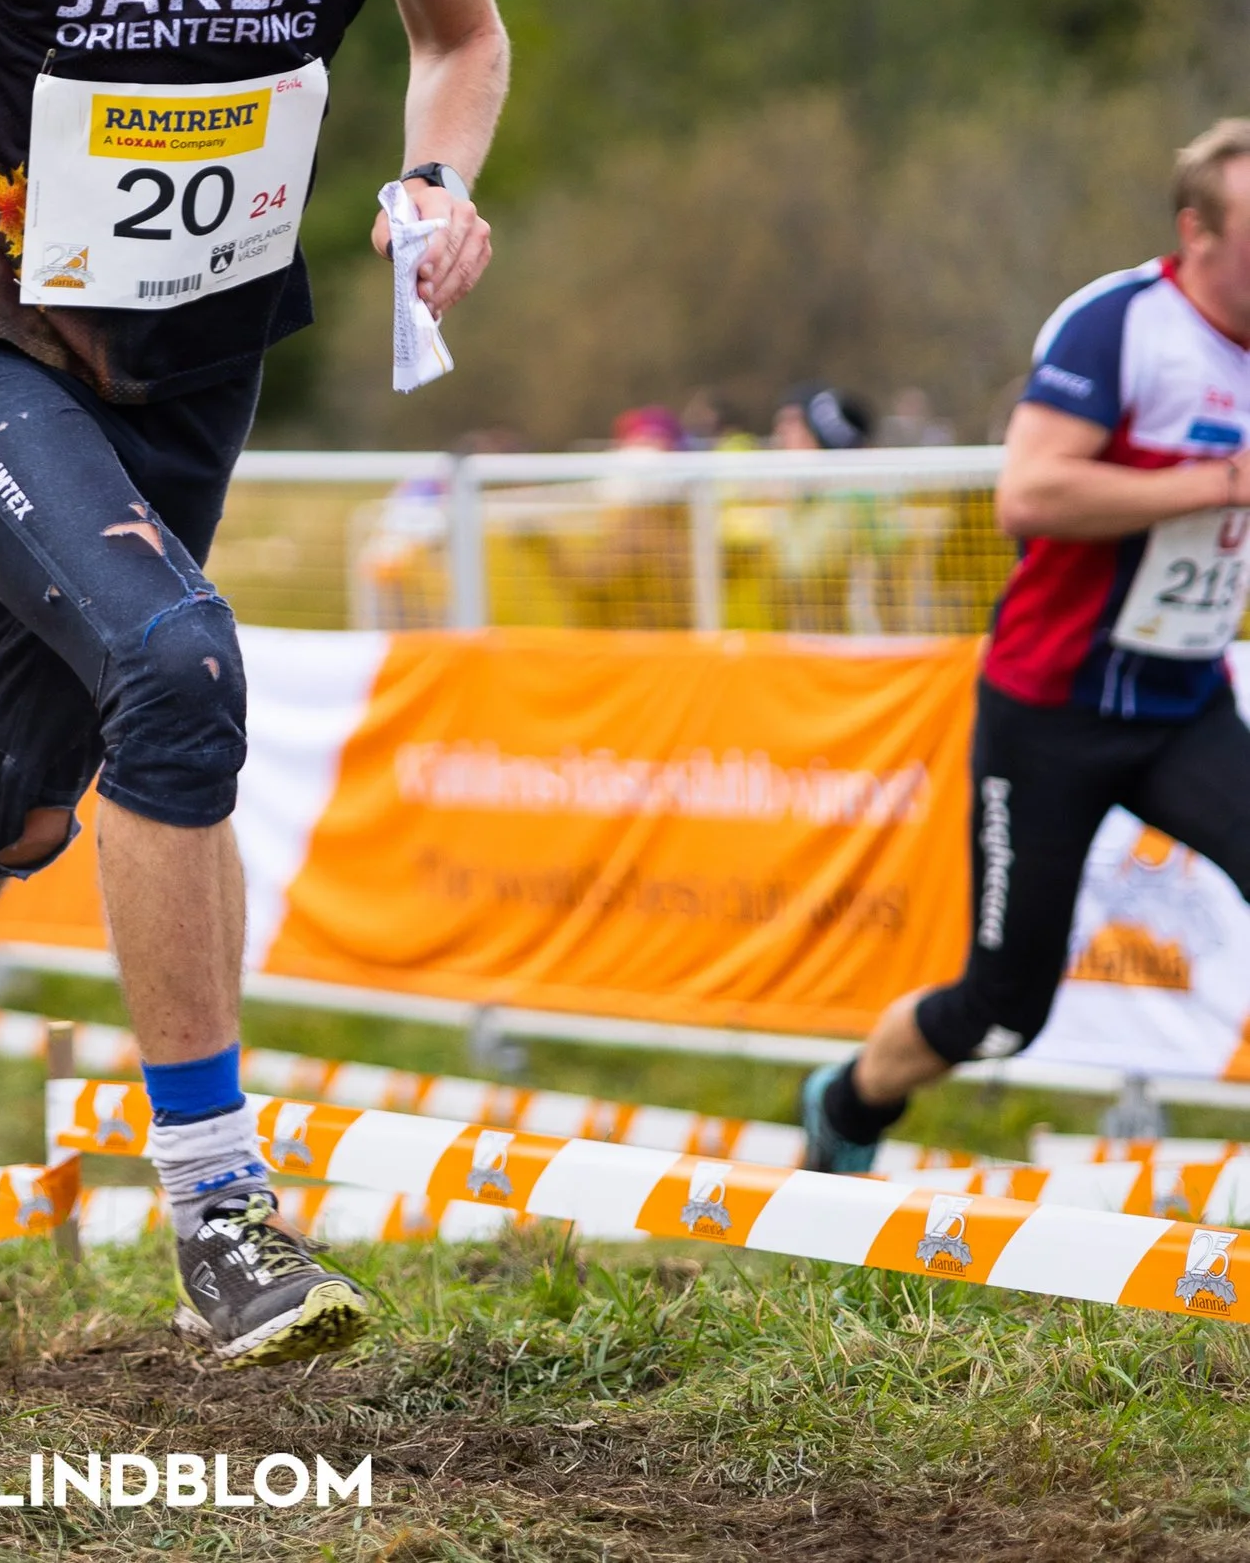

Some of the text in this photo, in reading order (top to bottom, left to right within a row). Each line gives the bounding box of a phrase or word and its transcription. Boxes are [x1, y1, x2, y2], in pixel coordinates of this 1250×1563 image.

[56, 10, 318, 50] ORIENTERING
[104, 102, 259, 132] RAMIRENT
[103, 135, 227, 150] A LOXAM Company
[113, 165, 235, 240] 20
[249, 184, 287, 219] 24
[238, 221, 292, 250] UPPLANDS
[1190, 1232, 1230, 1279] 25
